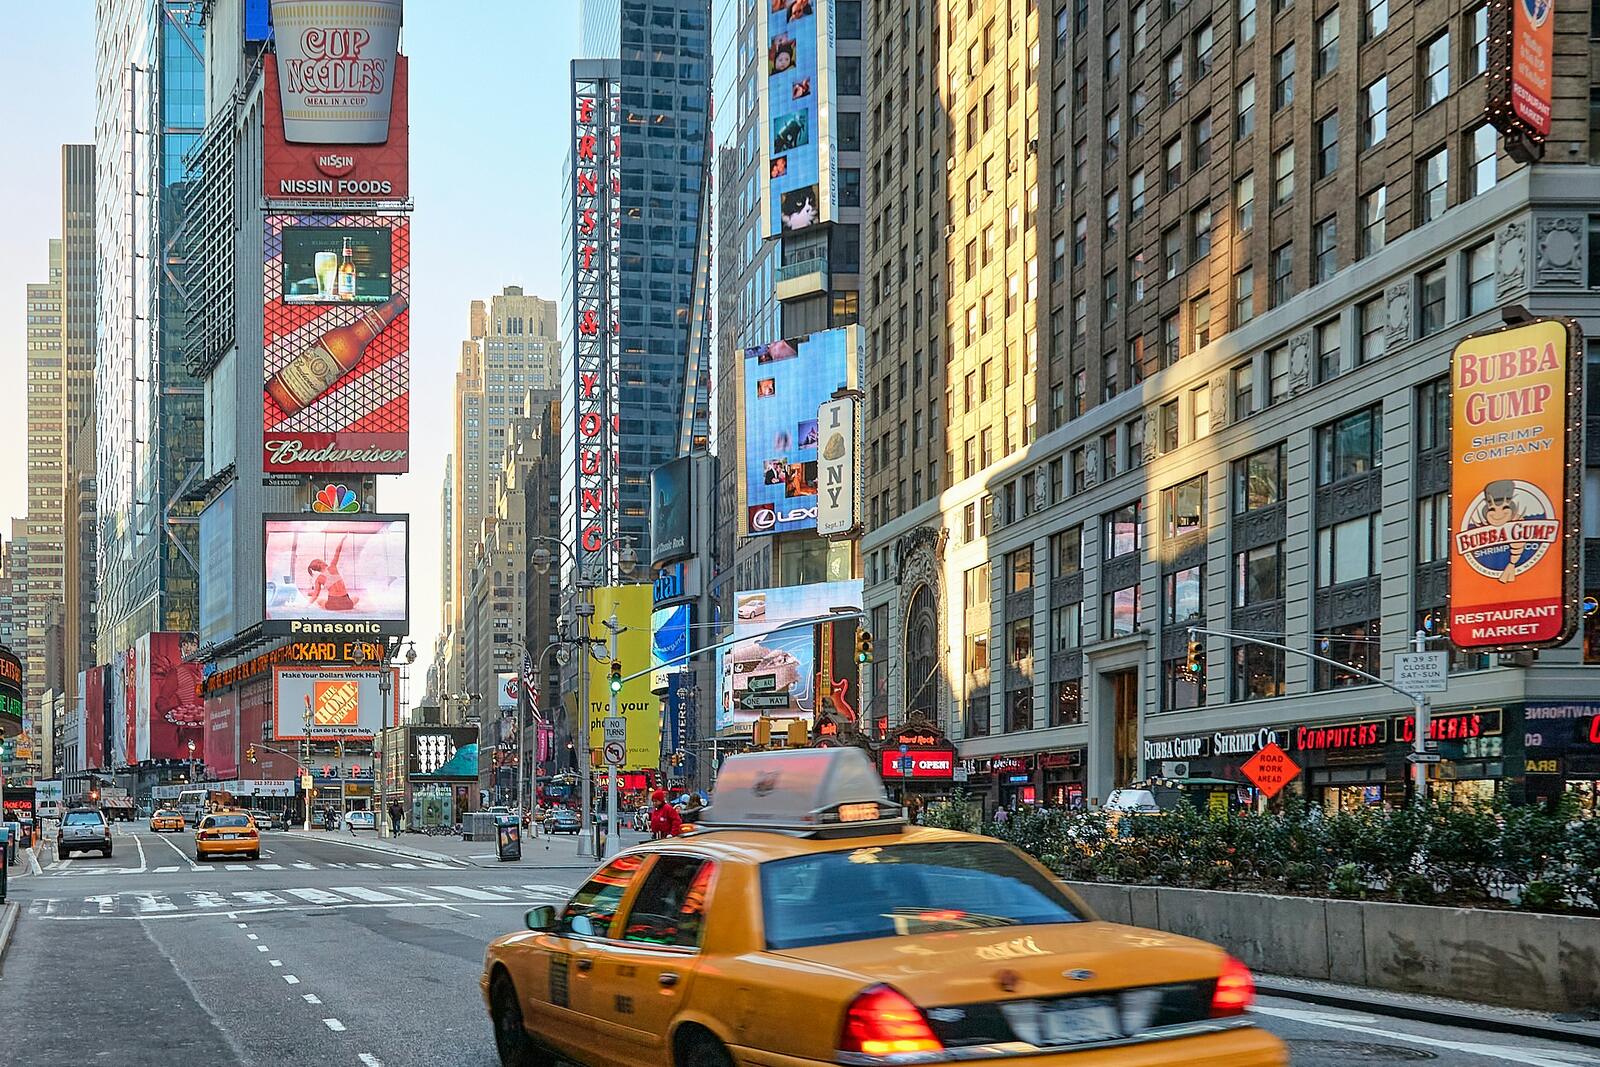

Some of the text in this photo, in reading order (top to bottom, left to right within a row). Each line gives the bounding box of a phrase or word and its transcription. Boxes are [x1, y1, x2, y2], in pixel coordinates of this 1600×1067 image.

[301, 27, 370, 60] CUP
[307, 97, 328, 105] MEAL
[331, 97, 340, 105] IN
[350, 97, 366, 105] CUP
[319, 155, 353, 168] NISSIN
[280, 179, 391, 194] NISSIN FOODS
[578, 98, 597, 269] ERNST
[1458, 342, 1559, 388] BUBBA
[1465, 384, 1551, 425] GUMP
[830, 407, 840, 428] I
[1472, 426, 1543, 447] SHRIMP
[264, 440, 408, 465] Budweiser
[1463, 439, 1553, 463] COMPANY
[580, 373, 602, 552] YOUNG
[1459, 523, 1556, 551] BUBBA GUMP
[1474, 542, 1539, 558] SHRIMP CO
[1455, 605, 1558, 624] RESTAURANT
[291, 621, 381, 633] Panasonic
[1472, 623, 1539, 639] MARKET
[314, 681, 358, 724] HOME
[319, 685, 338, 703] THE
[332, 697, 358, 725] DEPOT
[591, 702, 602, 712] TV
[621, 702, 649, 714] your
[606, 728, 625, 737] TURNS
[1297, 724, 1377, 750] COMPUTERS
[1144, 737, 1202, 760] BUBBA GUMP
[1214, 732, 1256, 755] SHRIMP
[919, 760, 950, 769] OPEN!
[1259, 765, 1283, 773] WORK
[1260, 755, 1283, 763] ROAD
[1257, 774, 1282, 782] AHEAD
